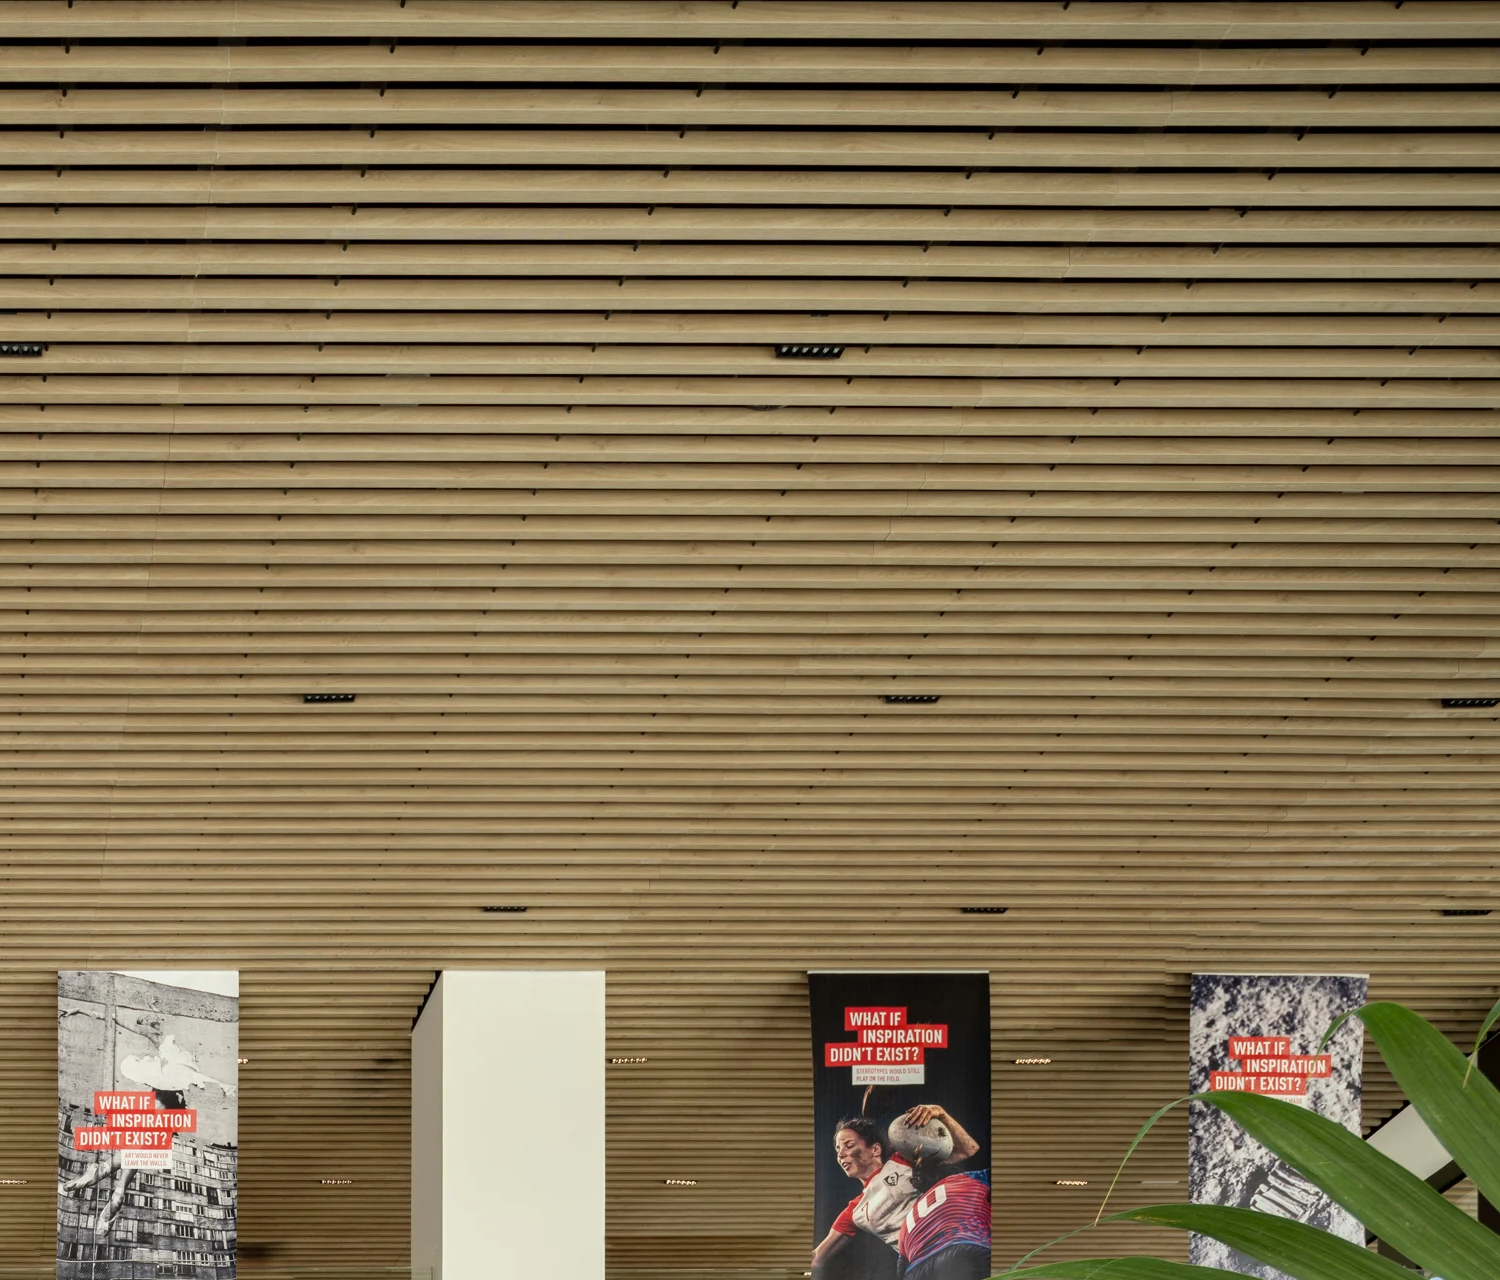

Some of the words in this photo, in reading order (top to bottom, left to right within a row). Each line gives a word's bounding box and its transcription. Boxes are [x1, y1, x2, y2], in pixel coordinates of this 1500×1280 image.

[849, 1012, 886, 1026] WHAT
[890, 1012, 901, 1026] IF
[863, 1029, 942, 1043] INSPIRATION
[830, 1047, 873, 1062] DIDN'T
[876, 1047, 919, 1061] EXIST?
[1233, 1041, 1270, 1055] WHAT
[1274, 1042, 1285, 1055] IF
[1246, 1059, 1326, 1074] INSPIRATION
[1215, 1076, 1256, 1090] DIDN'T
[1260, 1077, 1301, 1091] EXIST?
[99, 1096, 136, 1110] WHAT
[140, 1096, 151, 1110] IF
[112, 1114, 191, 1128] INSPIRATION
[80, 1132, 121, 1146] DIDN'T
[125, 1132, 167, 1146] EXIST?
[906, 1184, 948, 1234] 10
